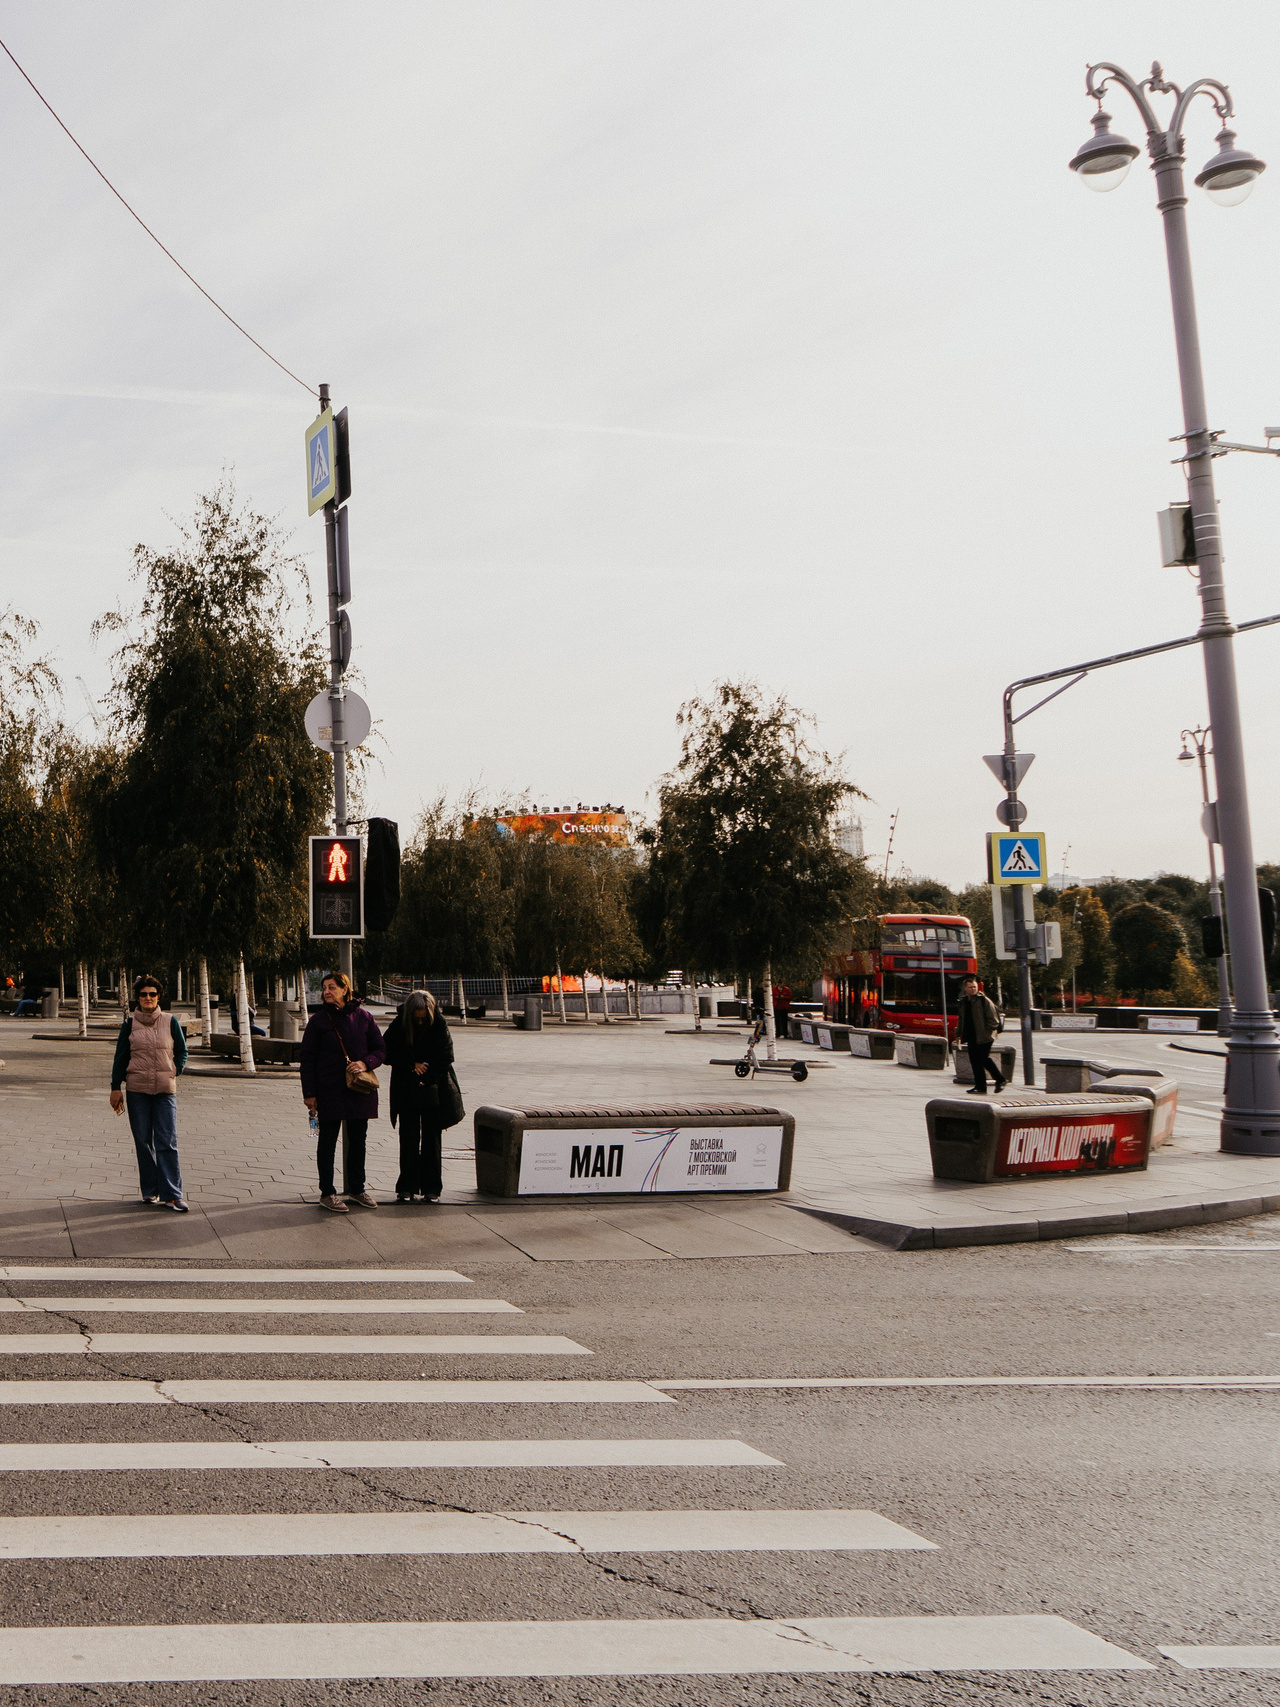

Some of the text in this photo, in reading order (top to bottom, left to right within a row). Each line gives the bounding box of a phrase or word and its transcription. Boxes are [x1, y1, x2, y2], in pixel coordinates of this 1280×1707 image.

[690, 1139, 723, 1150] ВЫСТАВКА
[570, 1144, 624, 1178] МАП
[688, 1150, 737, 1163] 7 МОСКОВСКОЙ
[687, 1164, 727, 1175] АРТ ПРЕМИИ
